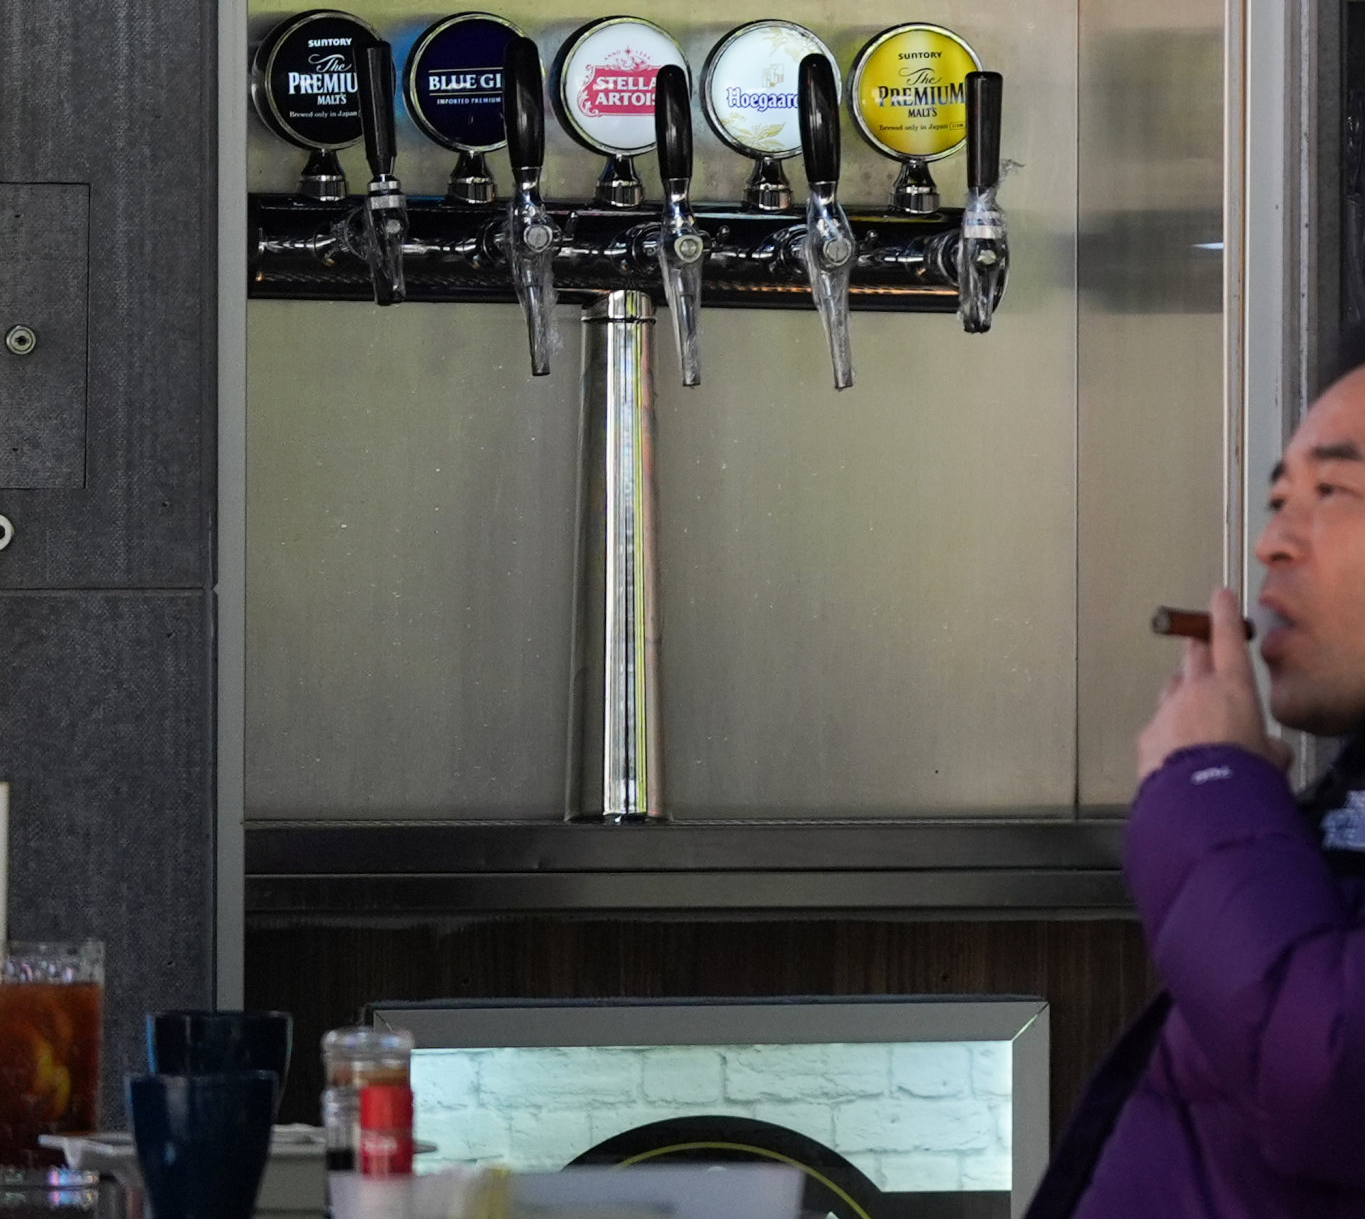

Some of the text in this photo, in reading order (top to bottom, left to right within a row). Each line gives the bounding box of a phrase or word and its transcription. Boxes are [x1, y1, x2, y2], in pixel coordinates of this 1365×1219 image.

[308, 37, 352, 48] SUNTORY
[308, 53, 353, 73] The
[898, 51, 942, 61] SUNTORY
[287, 71, 359, 95] PREMIU
[428, 73, 502, 92] BLUE GI
[898, 67, 942, 86] The
[593, 76, 657, 92] STELLA
[317, 93, 347, 106] MALT'S
[437, 97, 502, 106] IMPORTED PREMIUM
[726, 86, 800, 112] Hoegaar
[878, 82, 967, 108] PREMIUM
[289, 110, 358, 120] Brewed only in Japan
[908, 106, 938, 118] MALT'S
[905, 124, 919, 133] only
[919, 124, 927, 132] in
[928, 123, 949, 133] Japan
